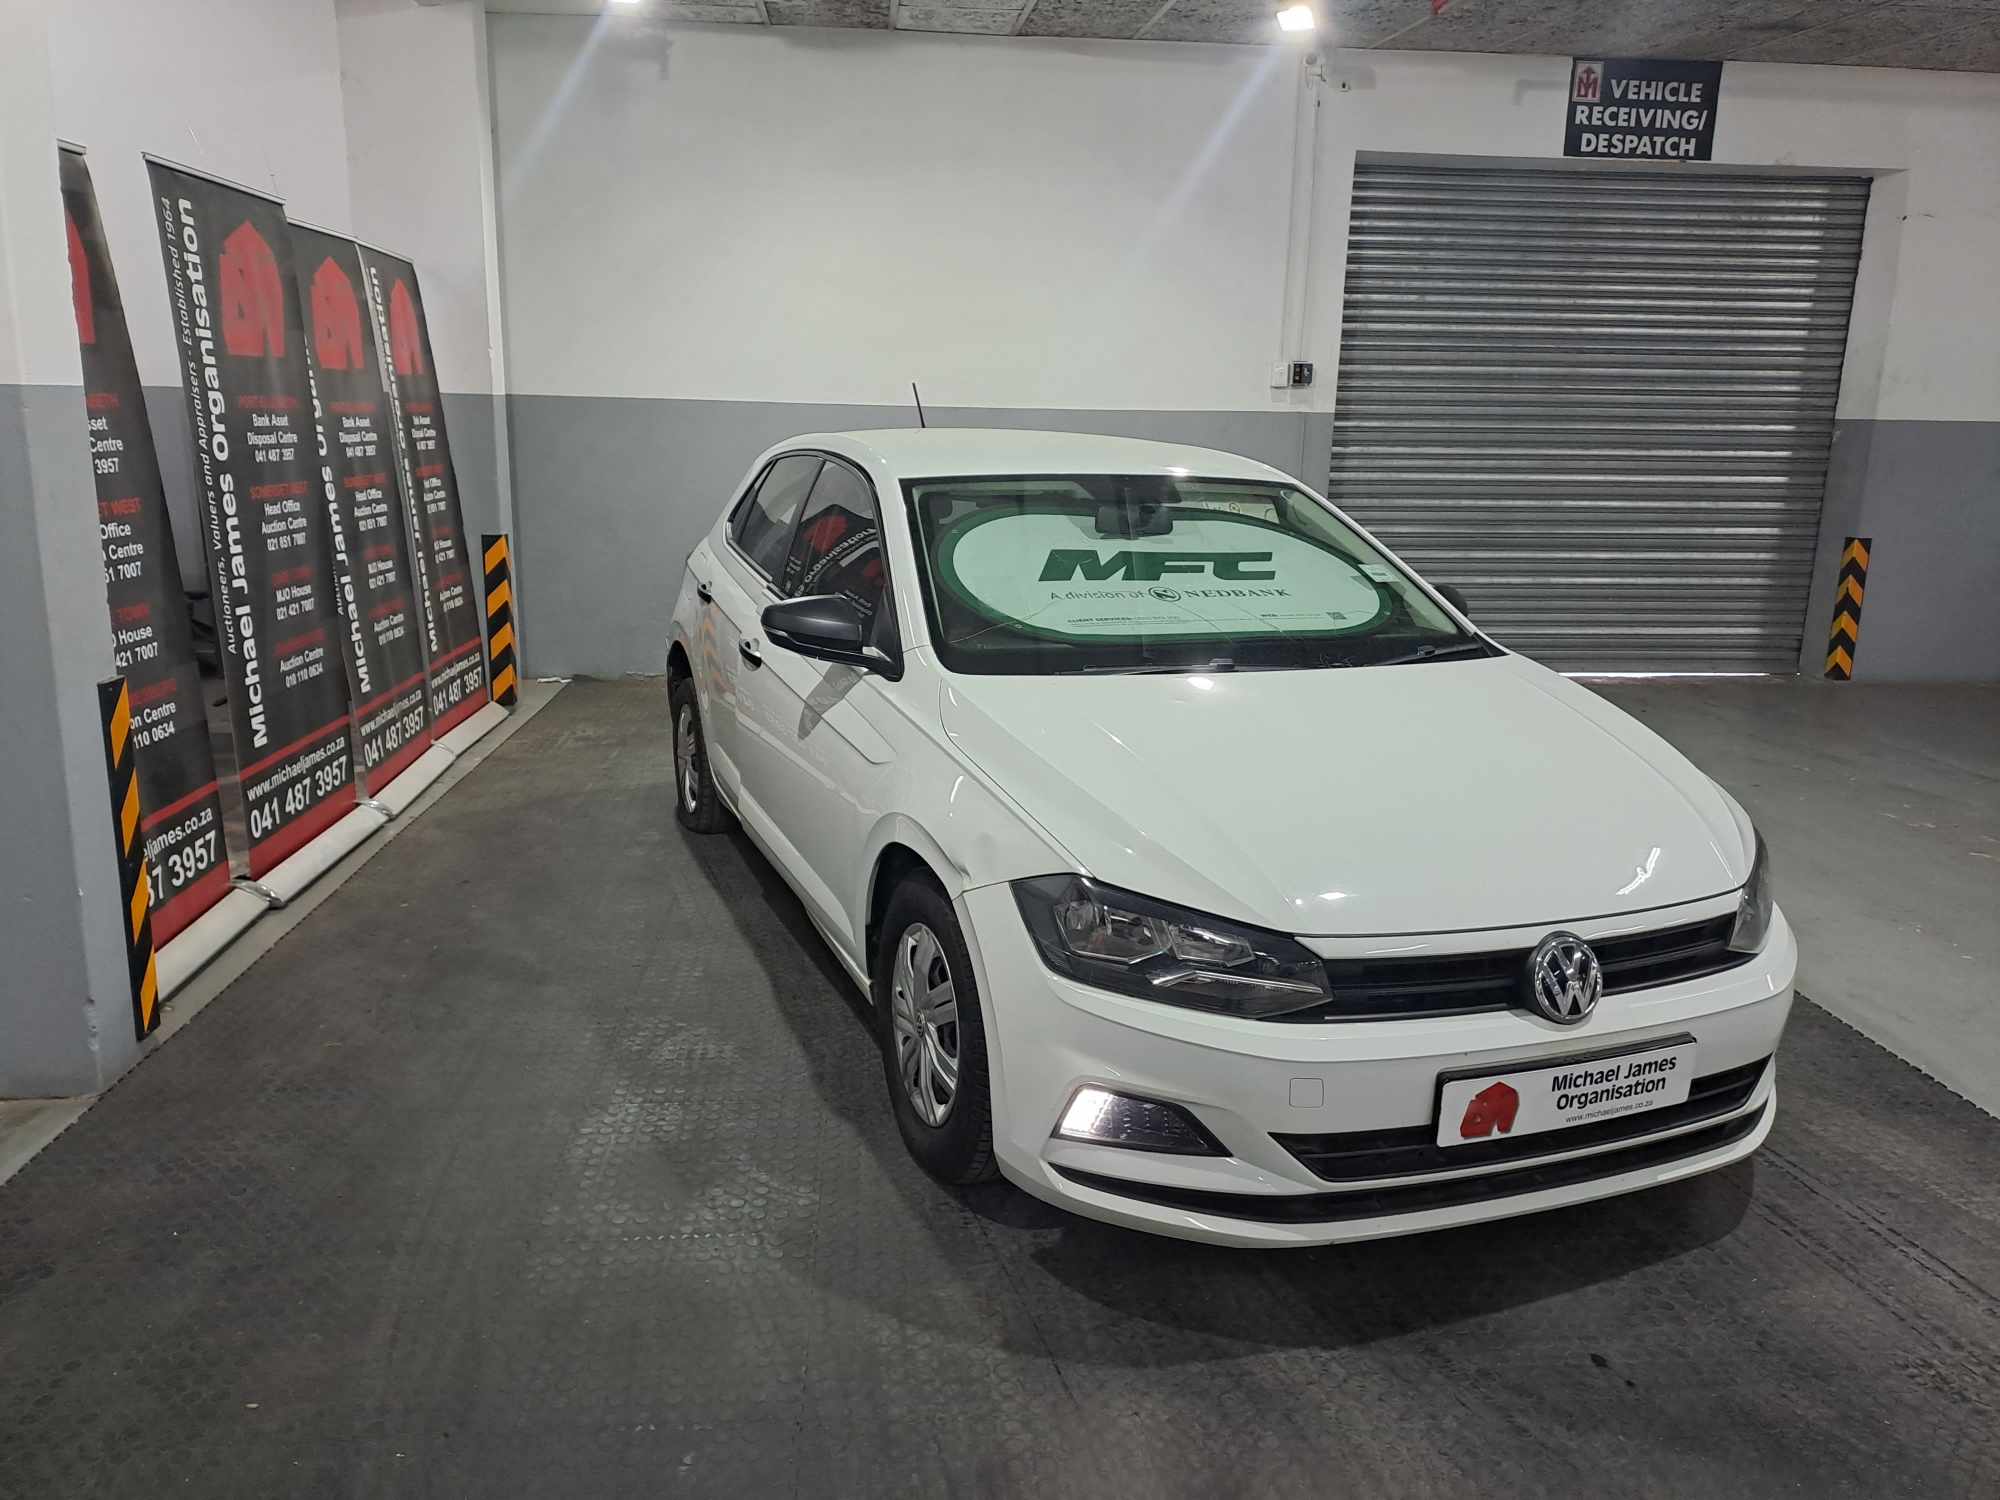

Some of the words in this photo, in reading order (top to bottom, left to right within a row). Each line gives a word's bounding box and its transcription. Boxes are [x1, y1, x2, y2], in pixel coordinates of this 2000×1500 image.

[1610, 79, 1704, 103] VEHICLE
[1574, 105, 1709, 131] RECEIVING/
[1580, 132, 1697, 157] DESPATCH
[161, 196, 176, 240] 1964
[168, 245, 192, 345] Established
[178, 198, 229, 461] Organisation
[188, 361, 208, 450] Appraisers
[90, 438, 124, 453] Centre
[95, 457, 119, 474] 3957
[200, 453, 214, 486] and
[208, 490, 222, 550] Valuers
[264, 502, 281, 517] Head
[321, 466, 349, 567] James
[100, 522, 131, 539] Office
[219, 473, 248, 595] James
[262, 520, 287, 536] Auction
[108, 542, 144, 560] Centre
[1038, 549, 1277, 582] MFC
[117, 561, 142, 580] 7007
[218, 556, 237, 654] Auctioneers,
[1050, 591, 1063, 600] A
[1065, 589, 1127, 601] division
[1131, 590, 1146, 600] of
[1184, 588, 1293, 599] NEDBANK
[118, 625, 153, 646] House
[340, 575, 372, 693] Michael
[115, 650, 133, 668] 421
[135, 641, 159, 661] 7007
[280, 656, 304, 672] Auction
[235, 604, 268, 749] Michael
[433, 689, 448, 716] 041
[449, 678, 462, 705] 487
[464, 666, 482, 694] 3957
[143, 701, 176, 723] Centre
[152, 720, 176, 743] 0634
[364, 735, 384, 768] 041
[385, 721, 402, 751] 487
[403, 705, 424, 739] 3957
[246, 736, 345, 801] www.michaeljames.co.za
[250, 797, 281, 839] 041
[284, 776, 311, 816] 487
[316, 755, 348, 797] 3957
[168, 830, 216, 887] 3957
[1552, 1065, 1621, 1092] Michael
[1624, 1056, 1677, 1079] James
[1556, 1076, 1667, 1110] Organisation
[1565, 1100, 1654, 1123] www.michaeljames.co.za
